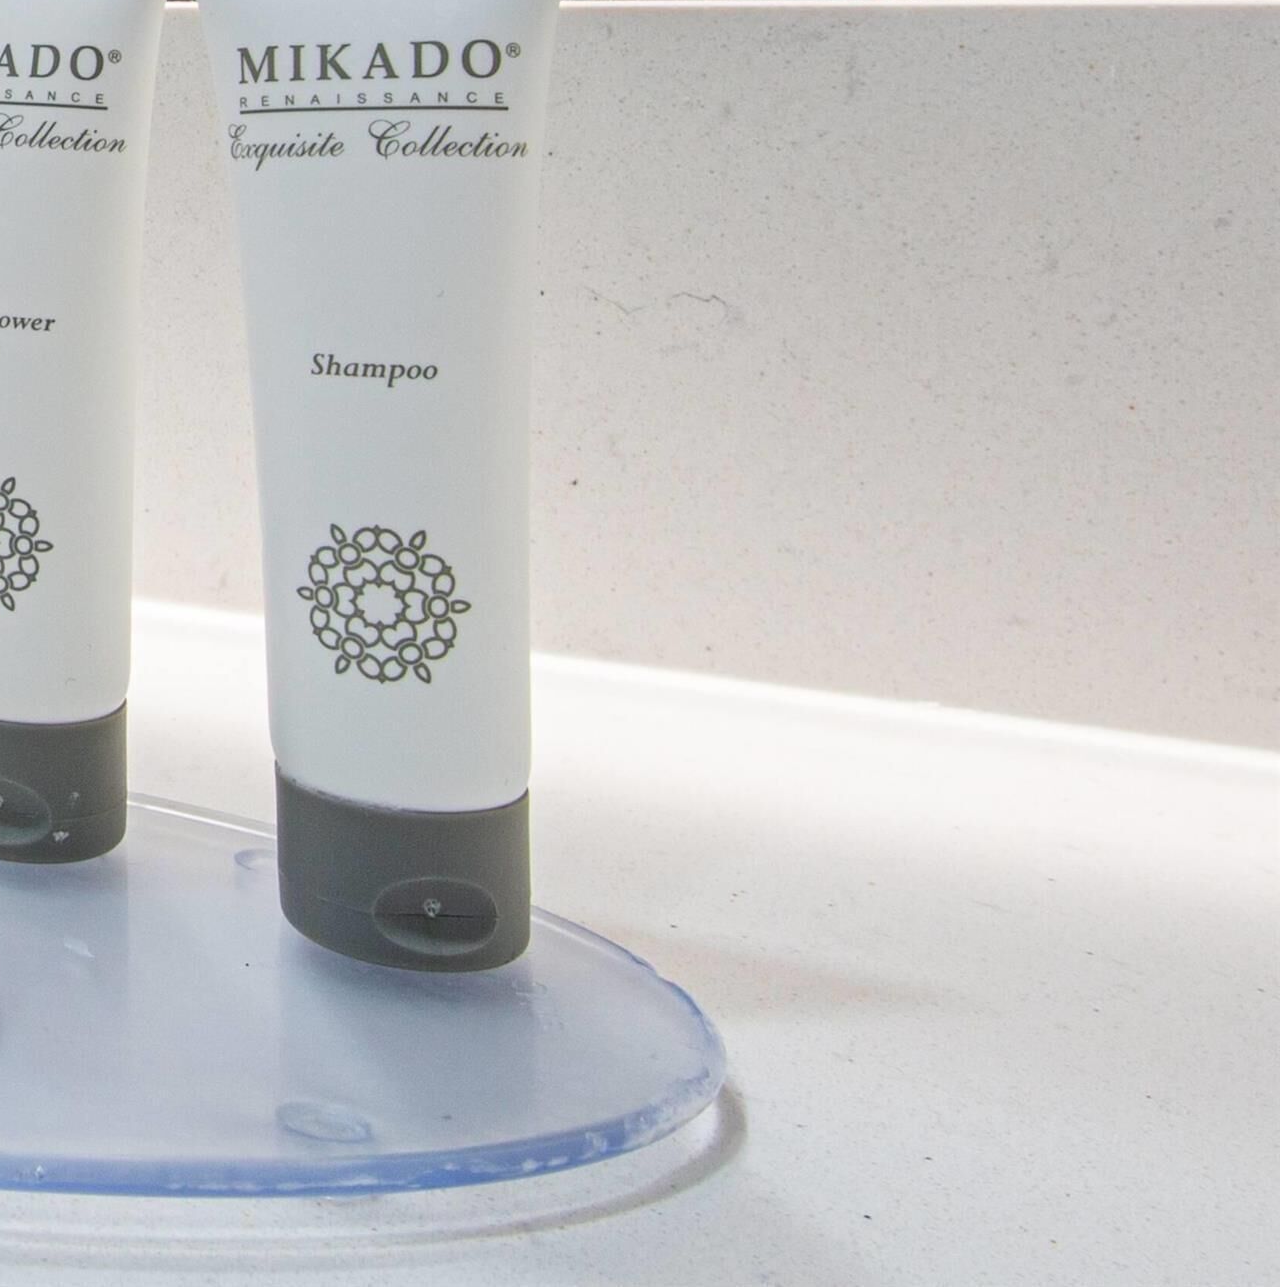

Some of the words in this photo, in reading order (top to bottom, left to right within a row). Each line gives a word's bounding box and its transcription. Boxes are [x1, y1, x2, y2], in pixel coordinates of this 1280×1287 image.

[240, 91, 505, 108] RENAISSANCE
[228, 123, 345, 171] Exquisite
[368, 119, 529, 160] Collection
[311, 353, 439, 388] Shampoo
